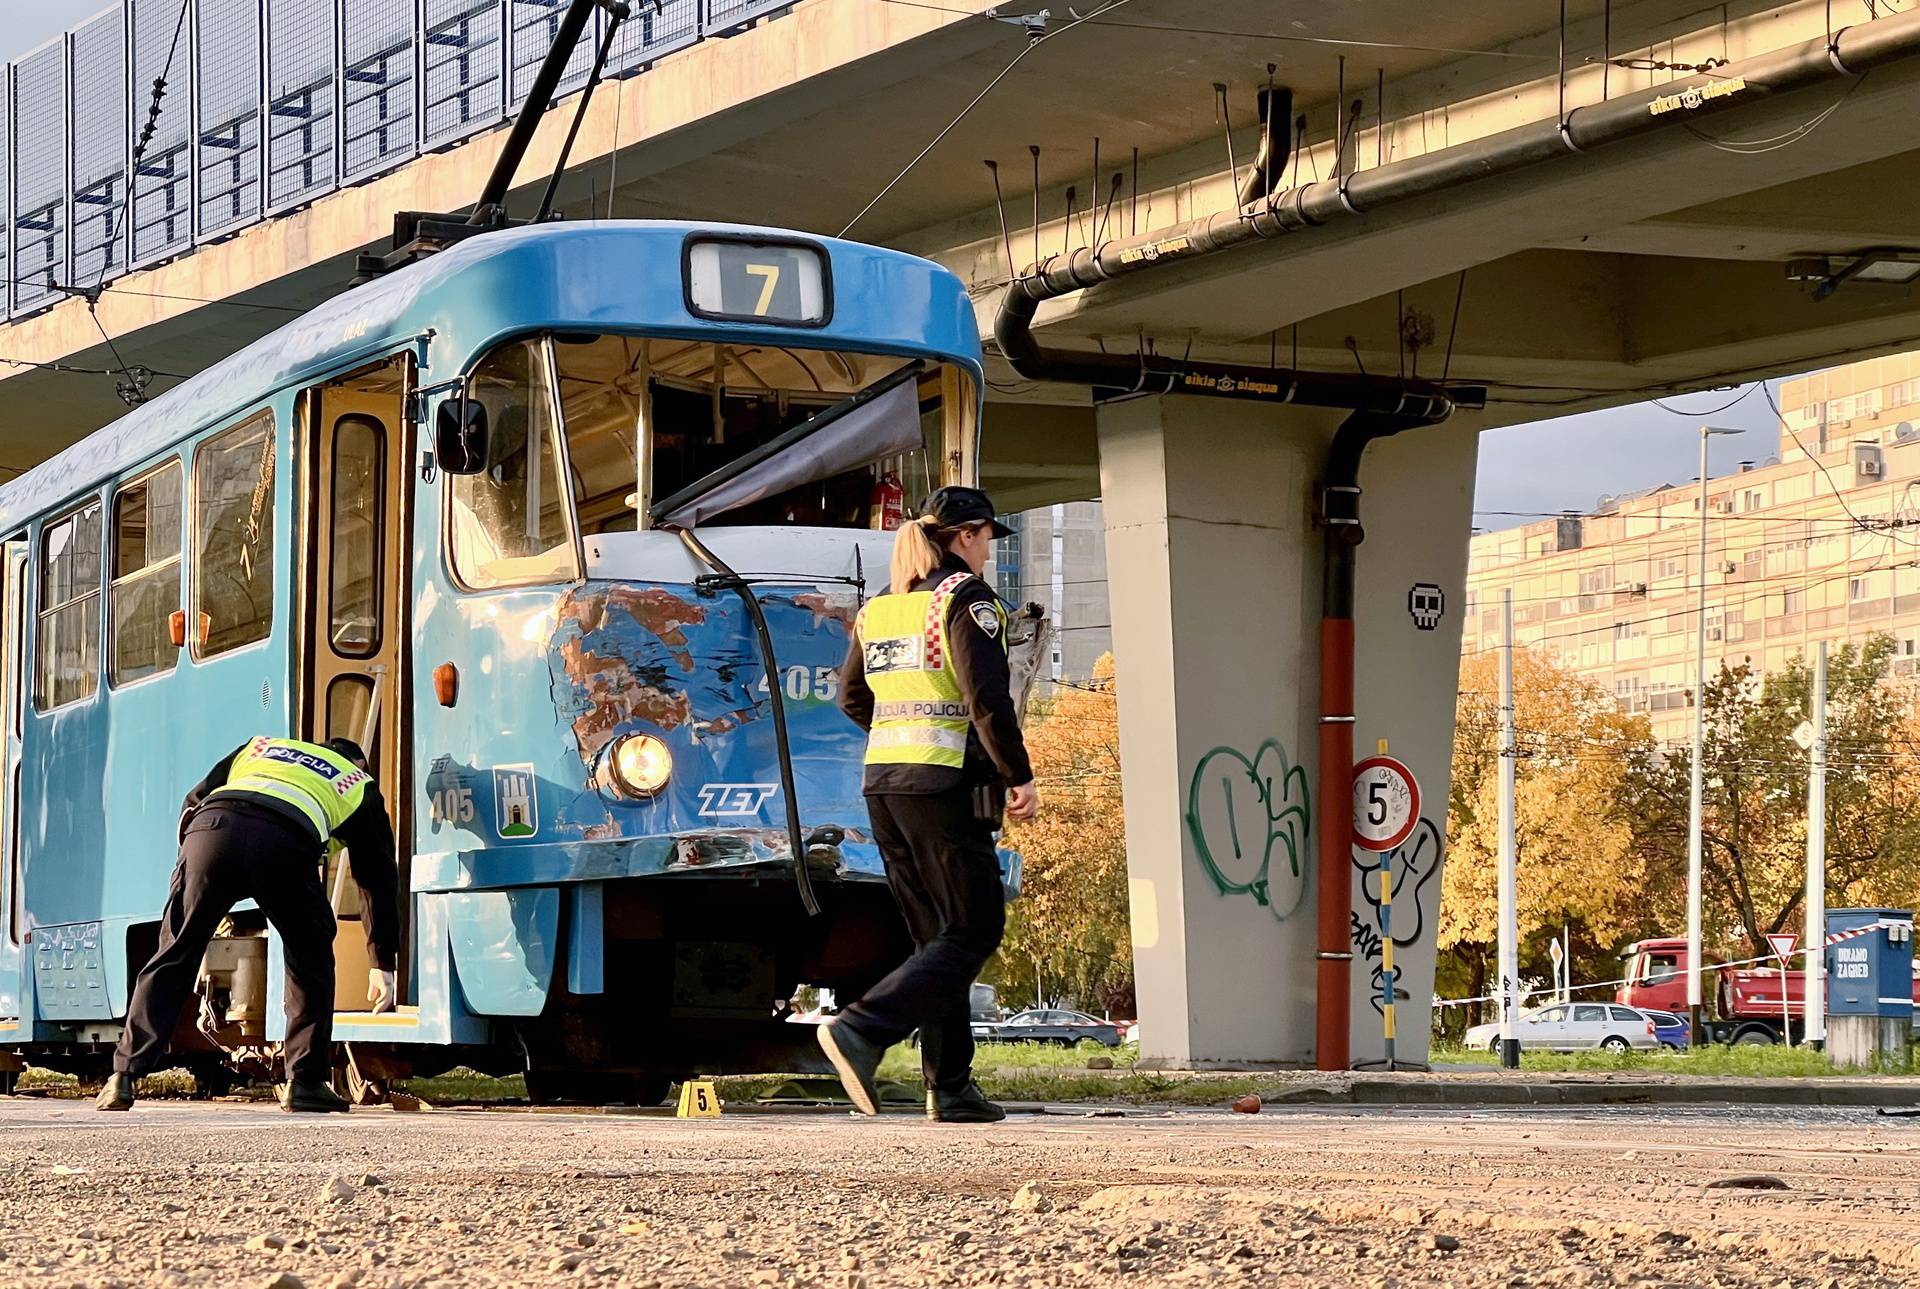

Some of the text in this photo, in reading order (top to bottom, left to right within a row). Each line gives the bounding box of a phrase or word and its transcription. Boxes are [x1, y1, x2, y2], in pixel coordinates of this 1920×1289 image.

[746, 263, 780, 316] 7
[267, 747, 332, 776] POLICIJA
[430, 788, 475, 824] 405
[1367, 782, 1388, 826] 5
[1837, 963, 1869, 978] ZAGREB
[1838, 947, 1868, 962] DINAMO
